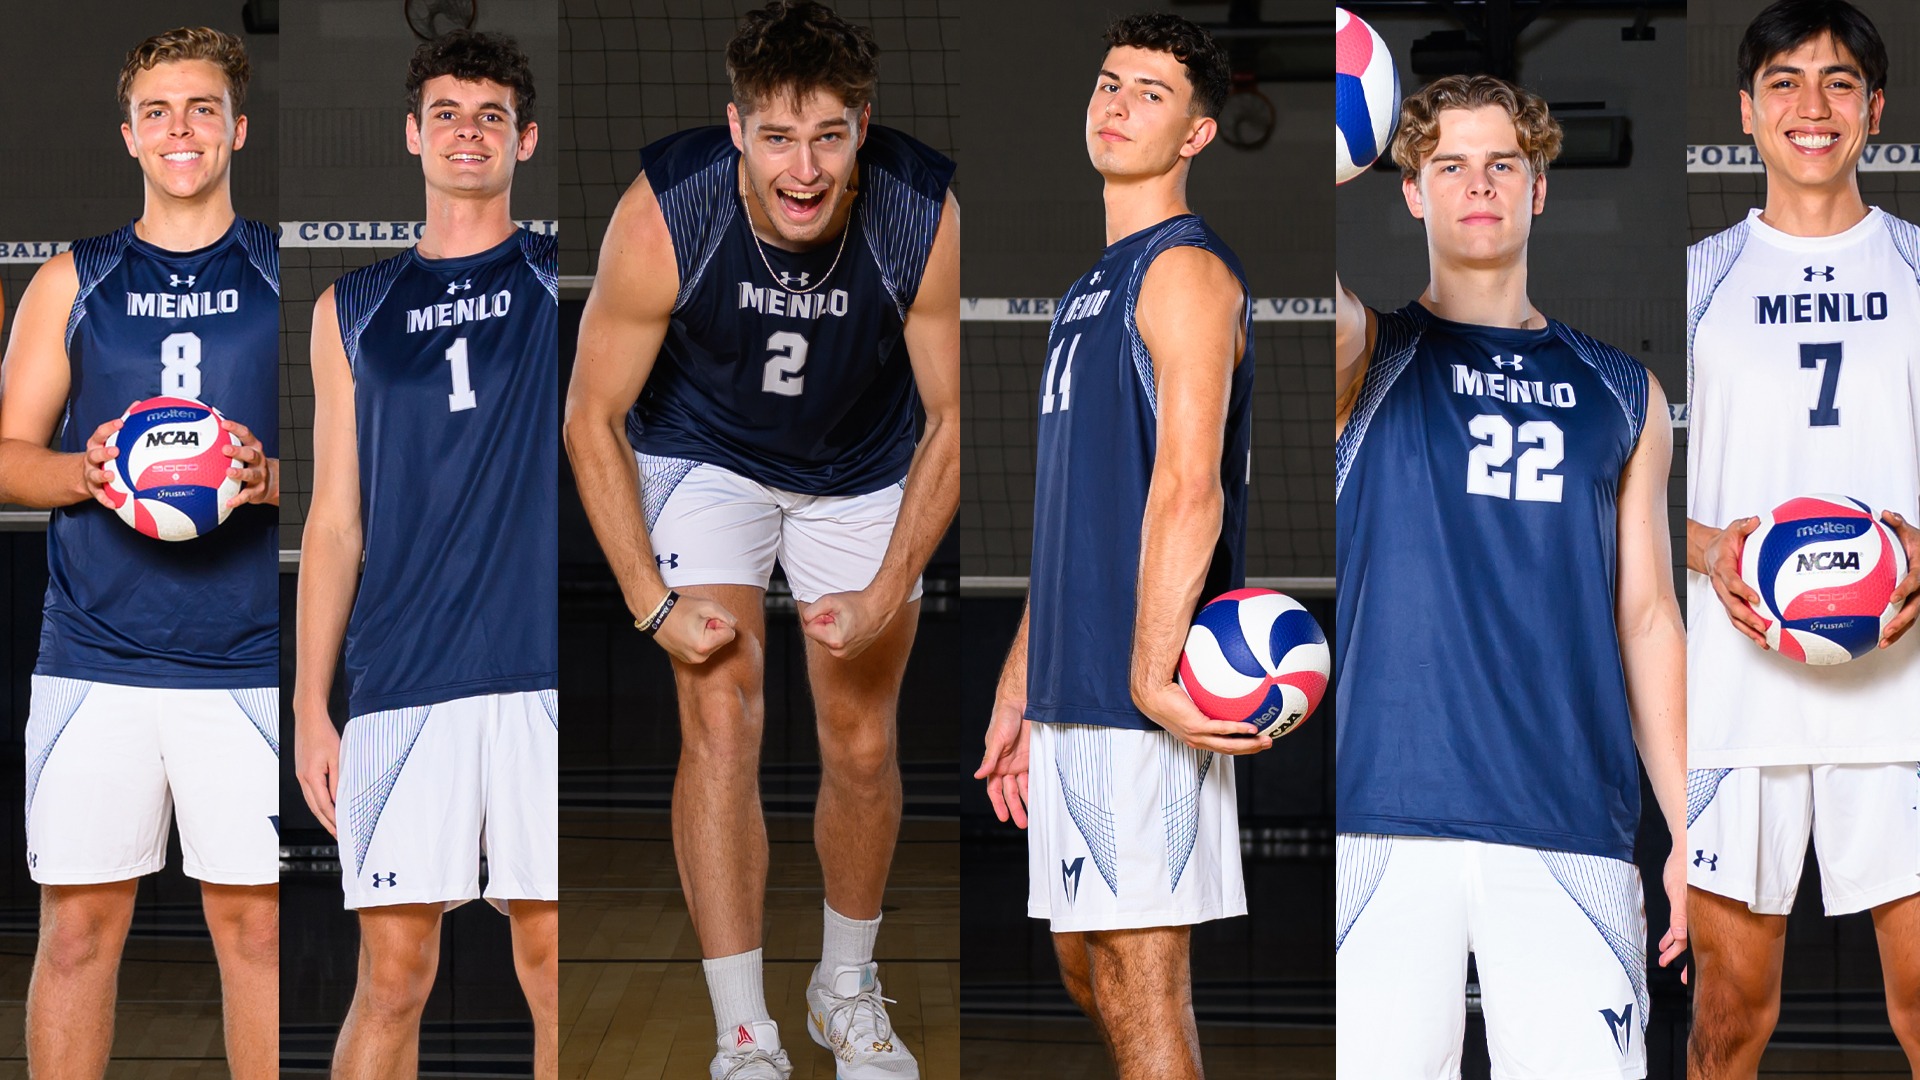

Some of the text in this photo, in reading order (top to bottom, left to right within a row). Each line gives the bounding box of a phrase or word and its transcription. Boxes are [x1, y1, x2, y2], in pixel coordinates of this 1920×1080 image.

[126, 289, 239, 318] MENLO
[406, 289, 512, 333] MENLO
[738, 281, 849, 320] MENLO
[1752, 291, 1888, 324] MENLO
[160, 331, 202, 399] 8
[445, 337, 477, 412] 1
[761, 330, 809, 397] 2
[1041, 332, 1082, 414] 14
[1450, 363, 1577, 408] MENLO
[1797, 340, 1844, 428] 7
[146, 409, 197, 421] molten
[145, 431, 199, 448] NCAA
[1466, 414, 1564, 503] 22
[1796, 522, 1856, 538] molten
[1796, 552, 1860, 572] NCAA
[1252, 705, 1280, 727] lten
[1269, 712, 1302, 738] CAA
